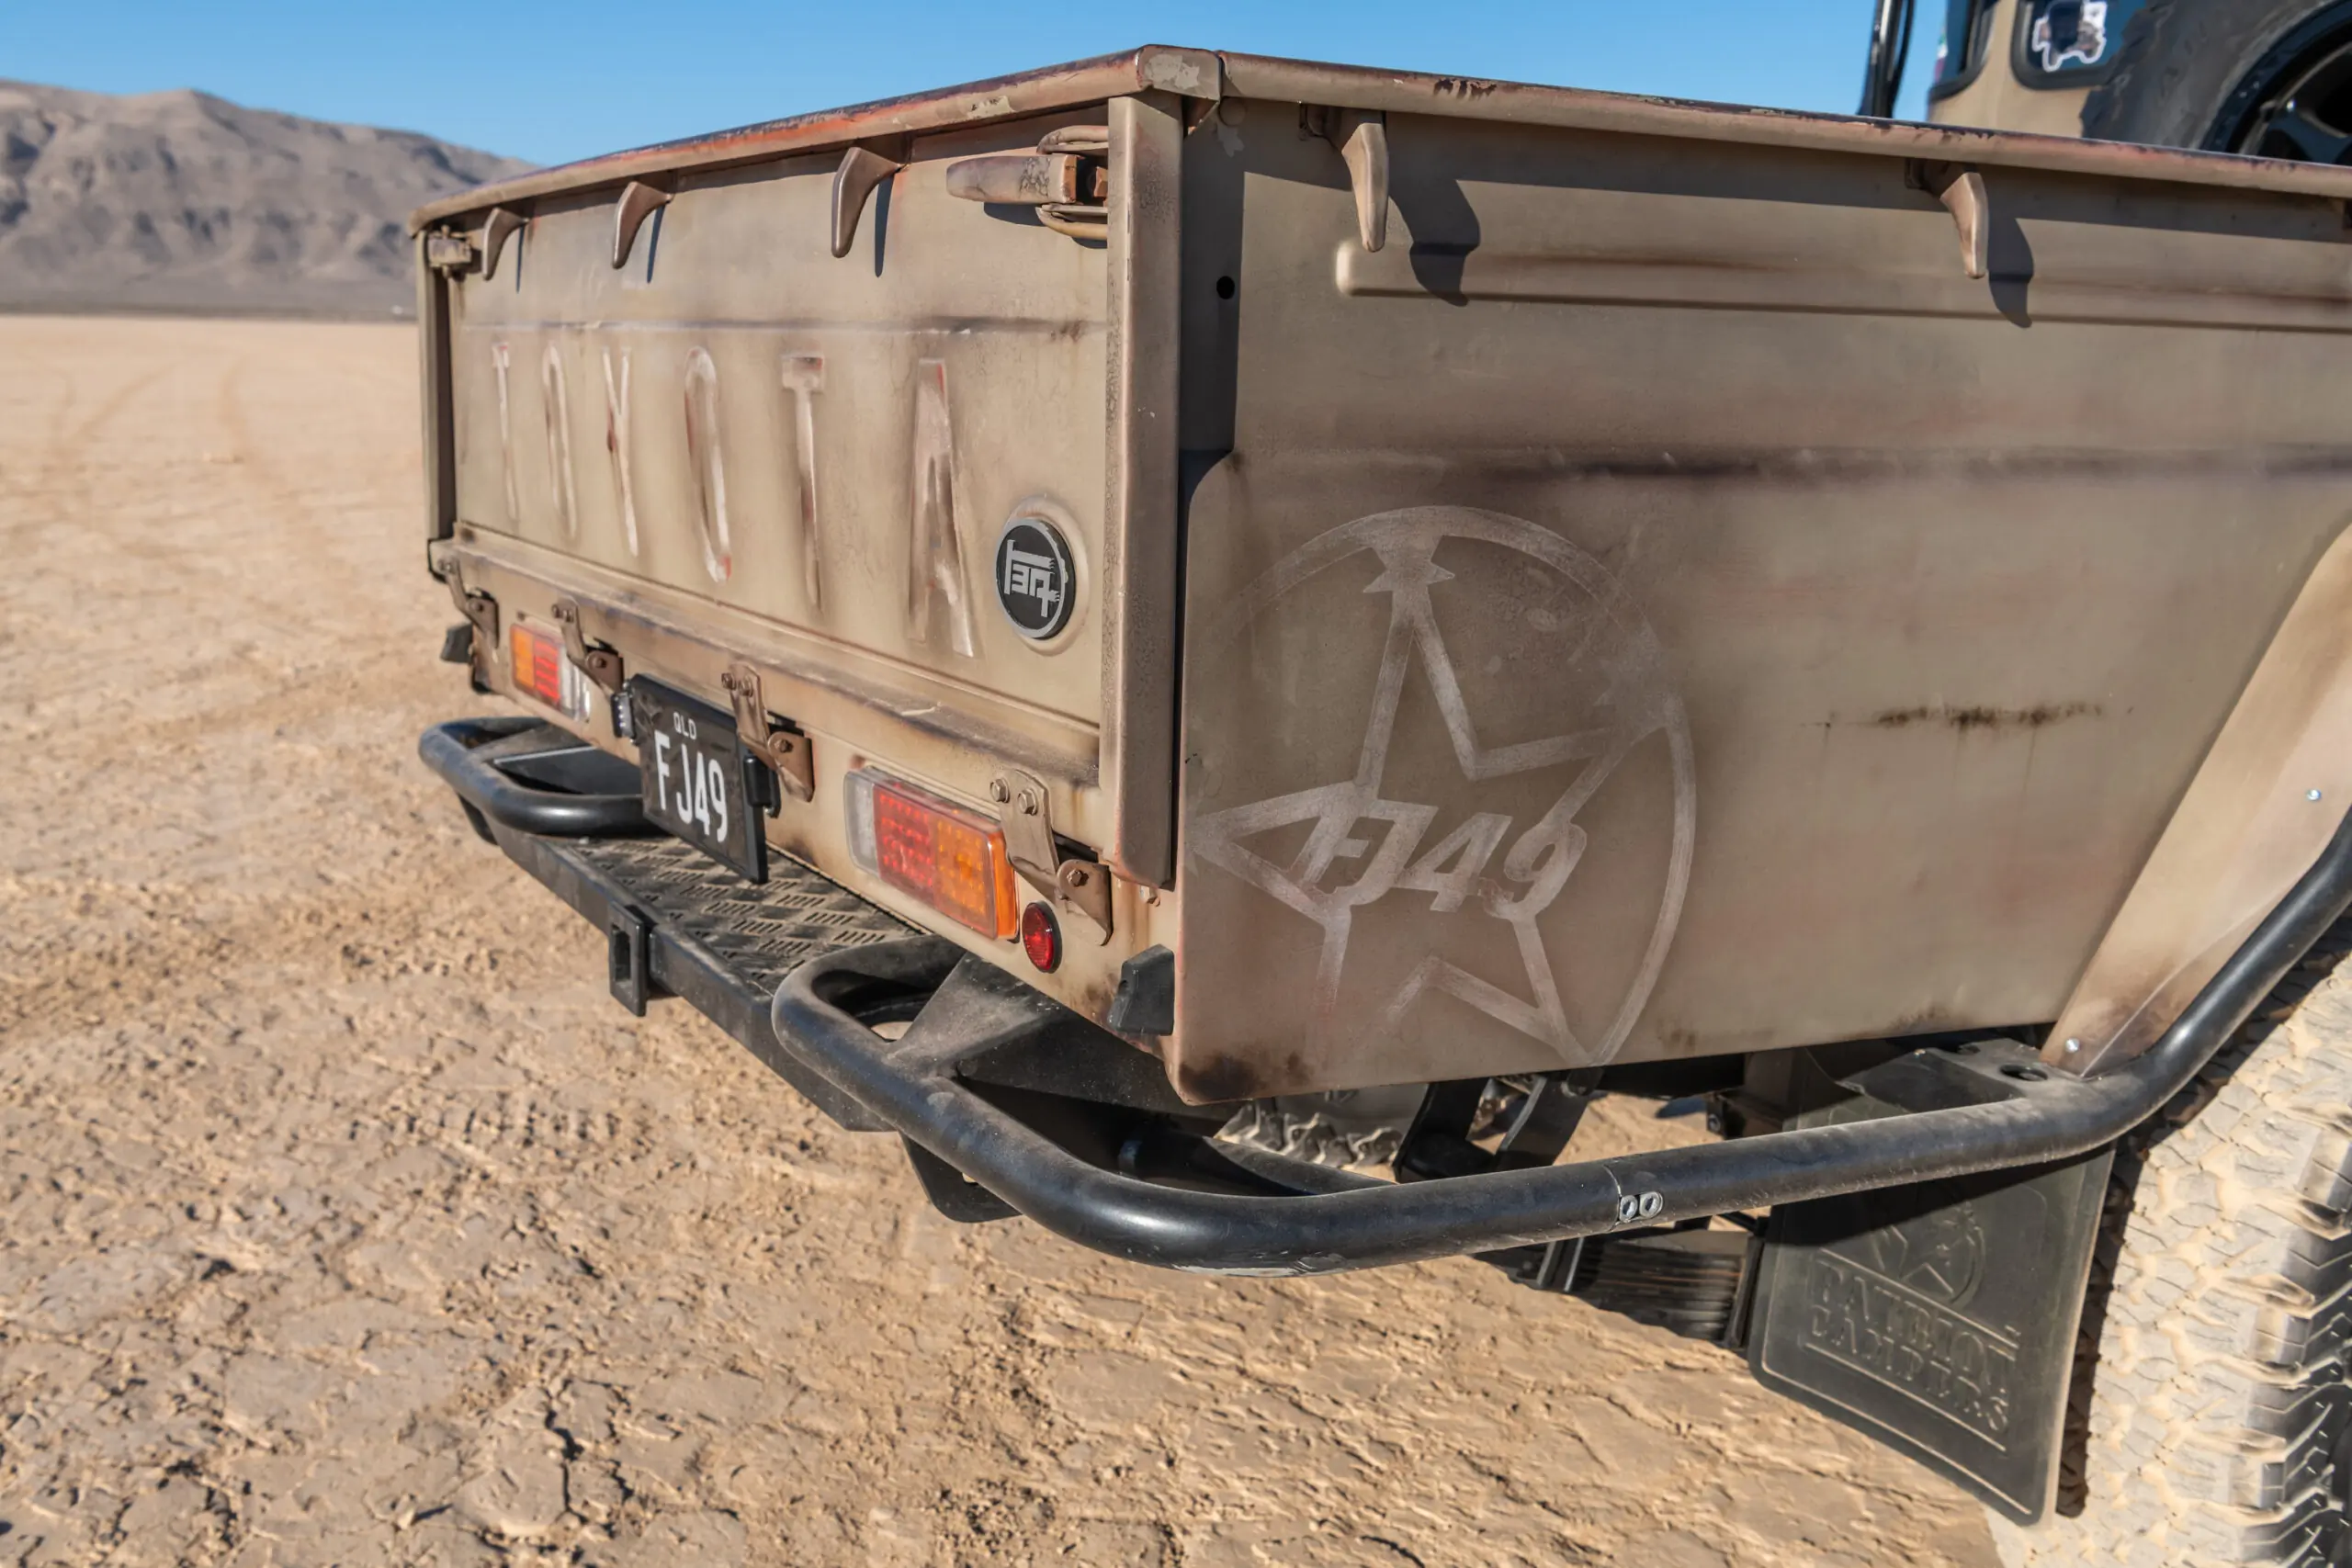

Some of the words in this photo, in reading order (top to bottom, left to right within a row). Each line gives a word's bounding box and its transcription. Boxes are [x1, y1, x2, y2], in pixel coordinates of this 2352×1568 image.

[492, 340, 977, 659] TOYOTA
[673, 711, 697, 740] QLD
[1288, 799, 1589, 920] FJ49
